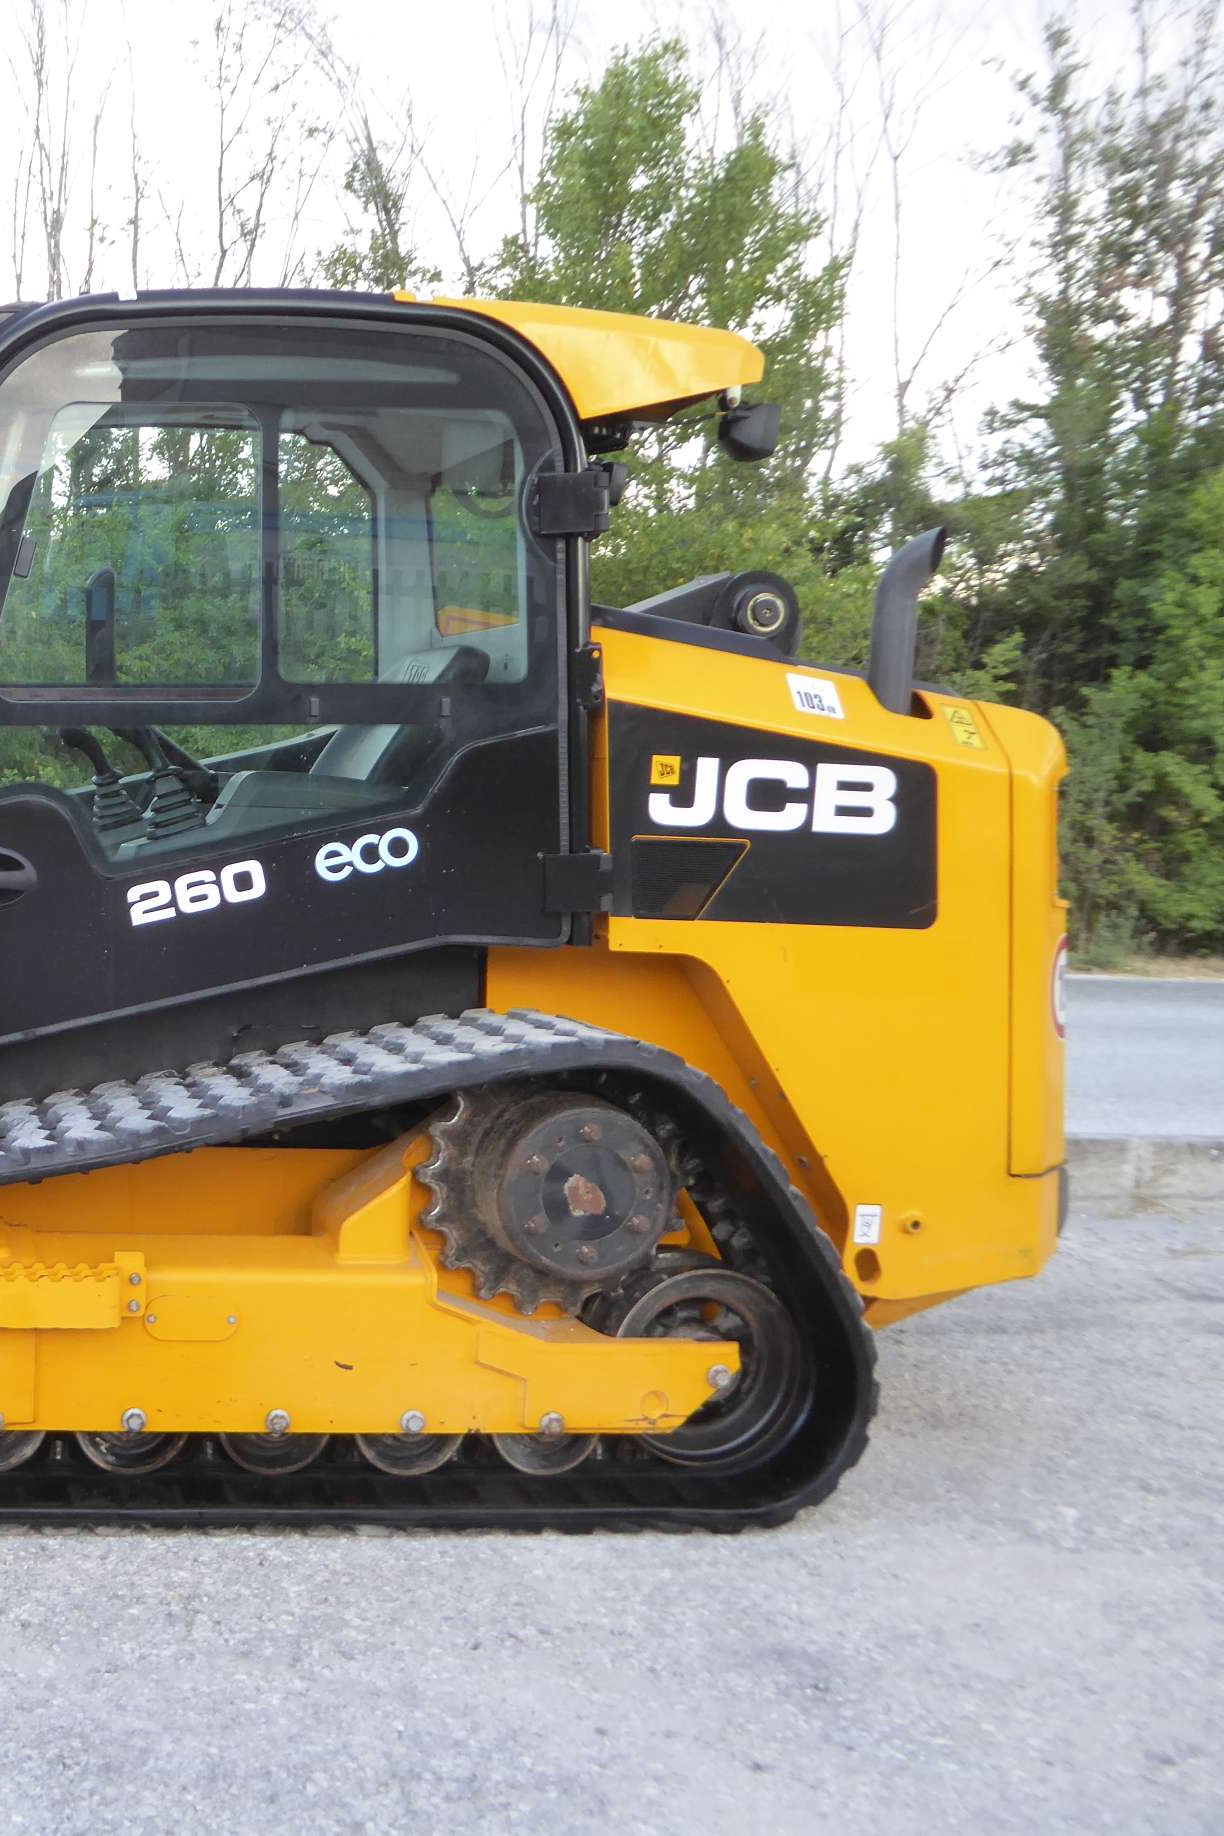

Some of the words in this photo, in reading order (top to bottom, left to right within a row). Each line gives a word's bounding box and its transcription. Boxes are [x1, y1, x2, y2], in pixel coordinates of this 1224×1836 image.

[796, 690, 825, 711] 103
[648, 757, 897, 835] JCB
[315, 827, 419, 882] eco
[126, 859, 267, 927] 260
